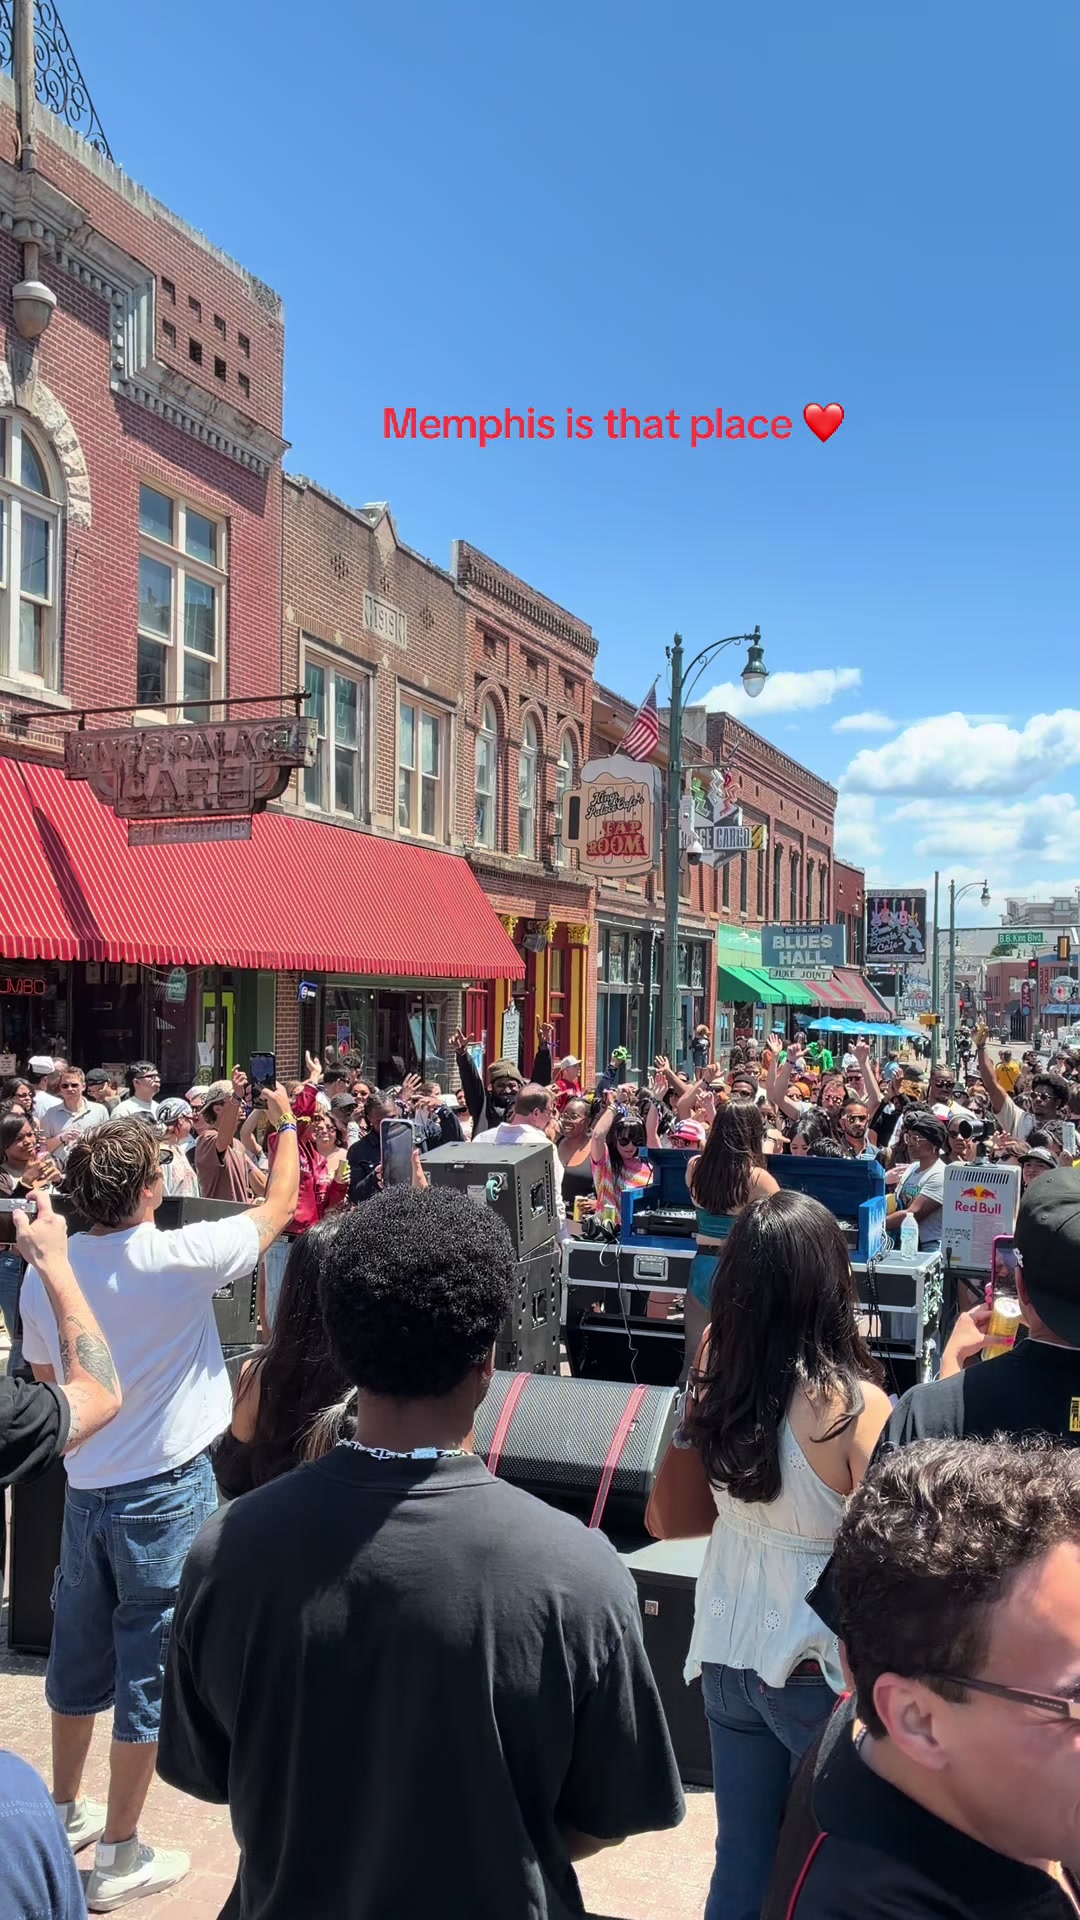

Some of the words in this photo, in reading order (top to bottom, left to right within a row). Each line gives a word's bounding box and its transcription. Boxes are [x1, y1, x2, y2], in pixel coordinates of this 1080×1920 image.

[121, 764, 245, 802] CAFE
[585, 803, 618, 820] Palace
[603, 820, 642, 836] TAP
[587, 835, 647, 856] ROOM
[716, 827, 750, 849] CARGO
[772, 934, 833, 949] BLUES
[779, 951, 826, 965] HALL
[773, 970, 796, 978] JUKE
[800, 970, 827, 980] JOINT
[955, 1200, 978, 1212] Red
[979, 1202, 1001, 1214] Bull
